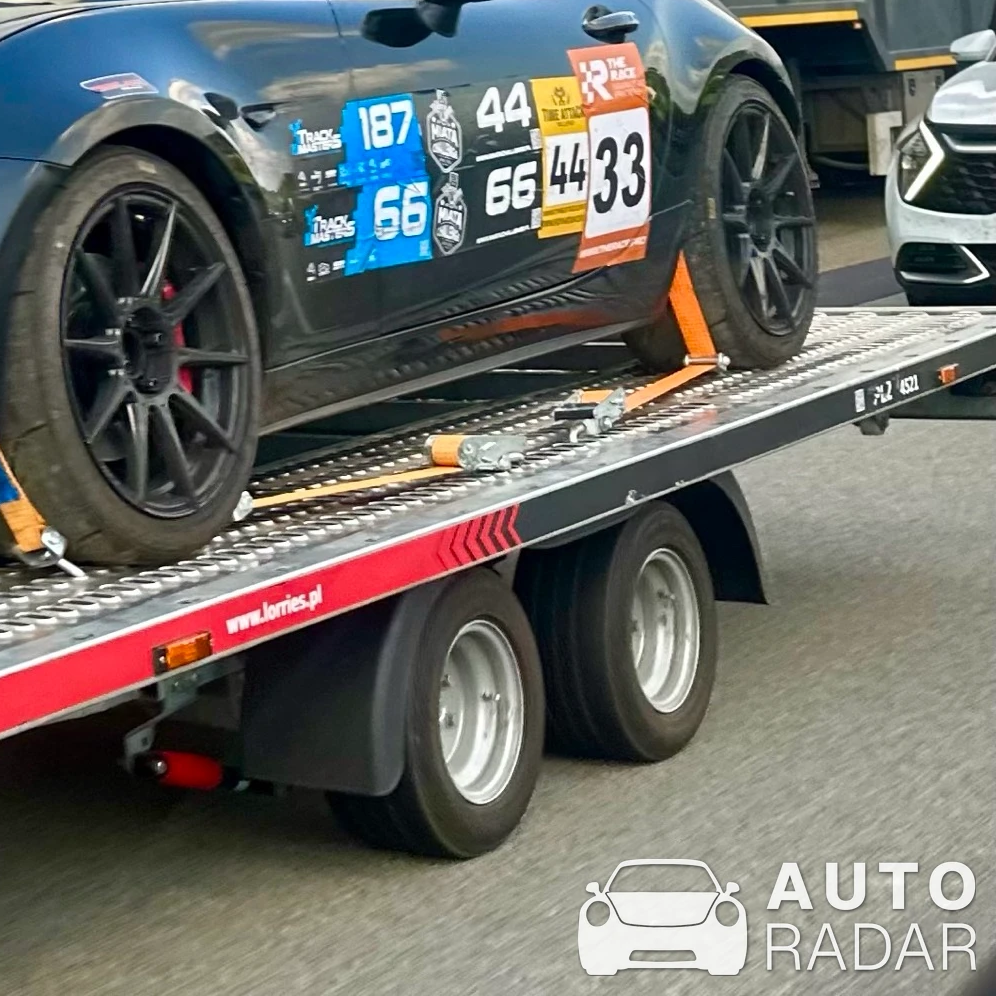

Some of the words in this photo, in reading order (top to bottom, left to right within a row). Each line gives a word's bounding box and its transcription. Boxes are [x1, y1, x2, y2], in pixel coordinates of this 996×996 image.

[606, 56, 627, 69] THE
[610, 67, 636, 81] RACE
[358, 99, 413, 150] 187
[476, 81, 531, 133] 44
[486, 161, 538, 216] 66
[550, 142, 586, 194] 44
[593, 131, 646, 214] 33
[374, 181, 429, 240] 66
[226, 584, 323, 634] www.lorries.pl
